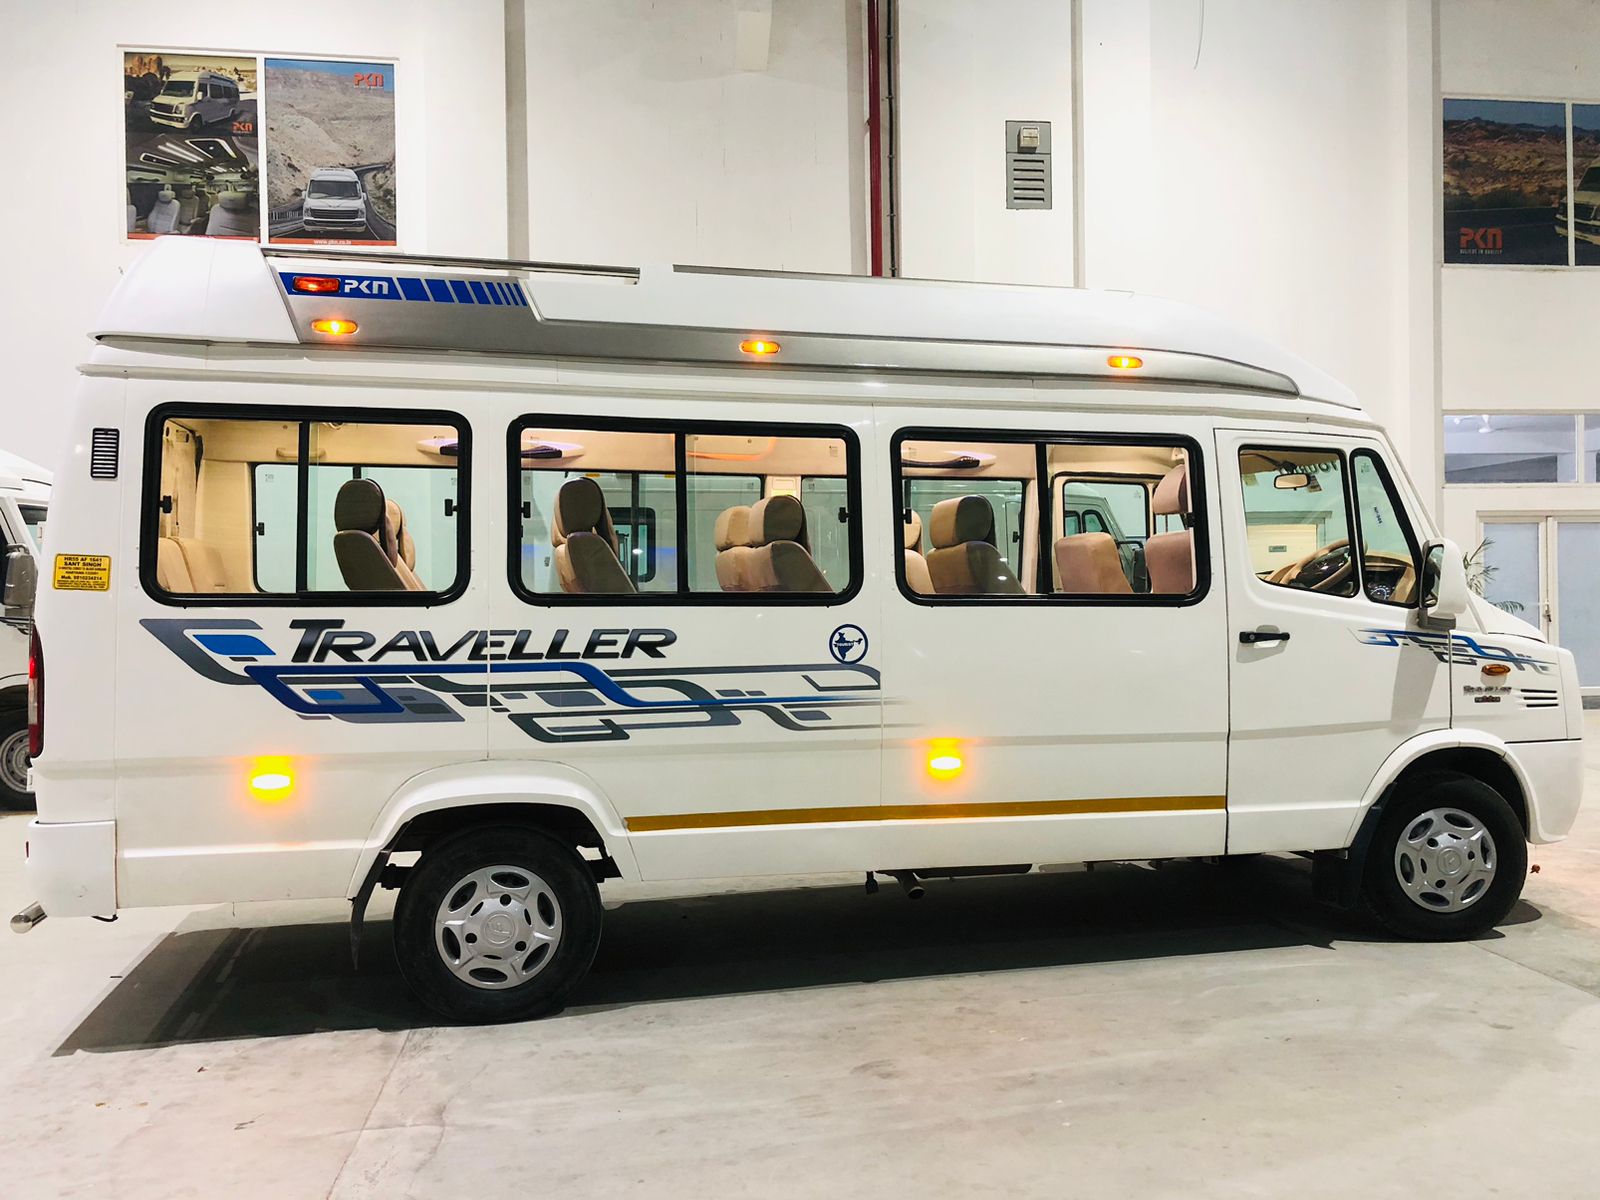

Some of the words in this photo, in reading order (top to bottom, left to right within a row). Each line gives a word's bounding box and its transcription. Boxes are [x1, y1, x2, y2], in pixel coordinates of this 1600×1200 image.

[354, 72, 384, 86] PKN
[233, 122, 253, 131] PKN
[1459, 227, 1503, 248] PKN
[344, 279, 389, 294] PKN
[289, 618, 678, 663] TRAVELLER
